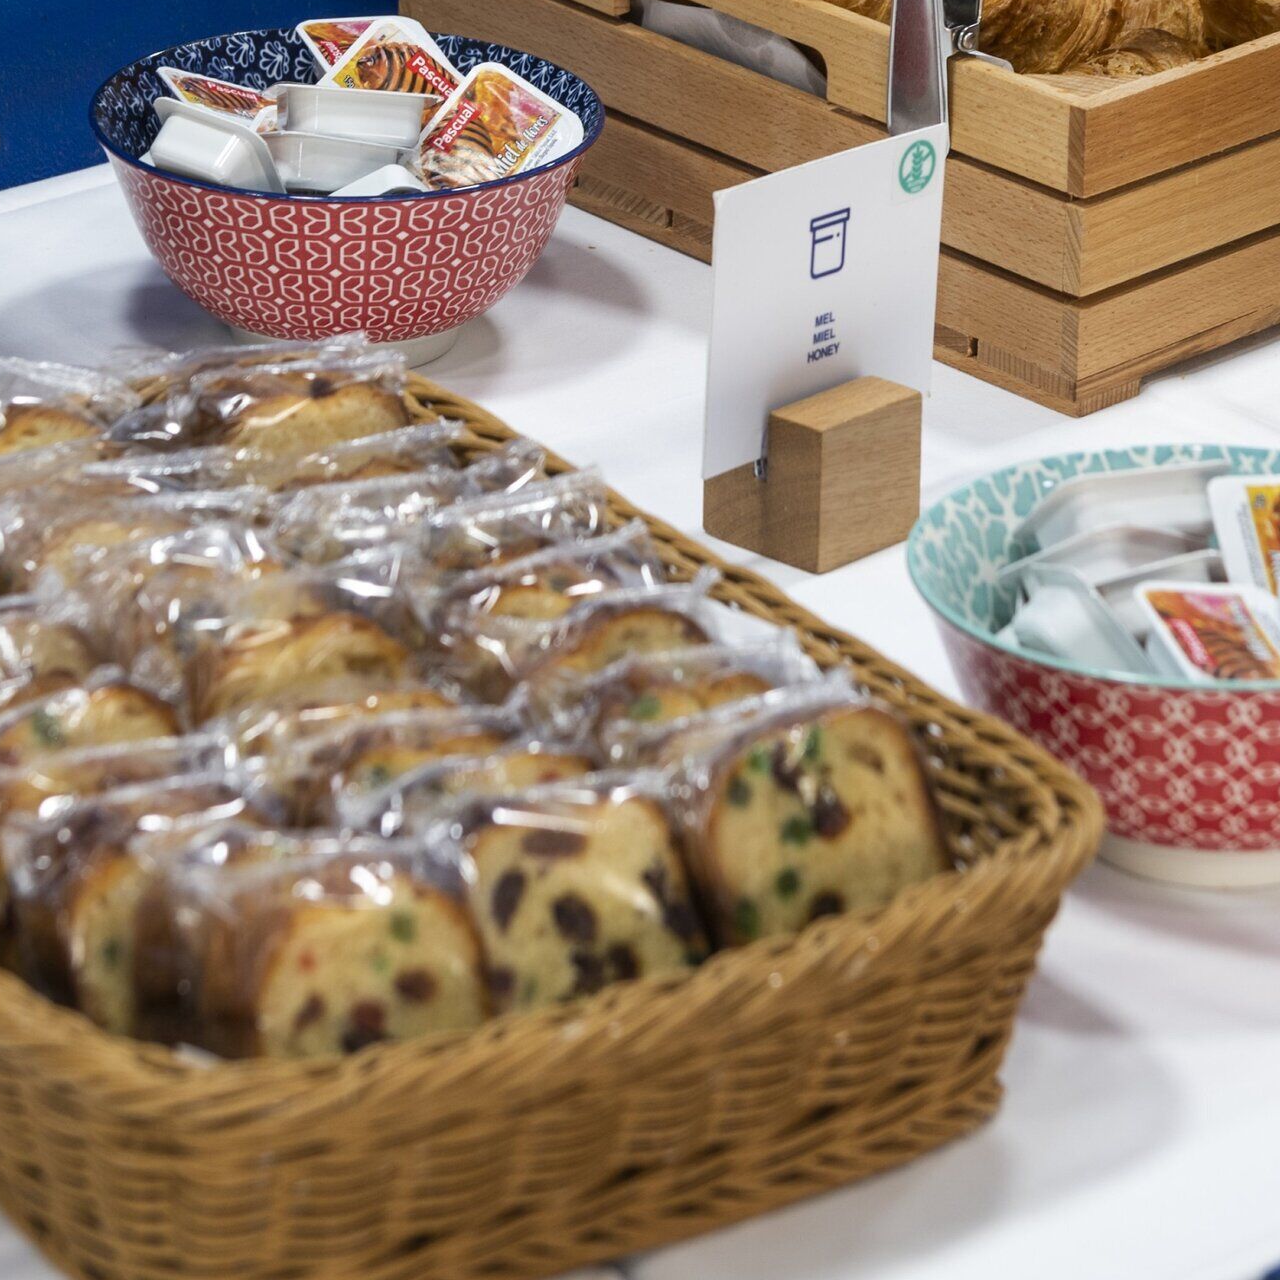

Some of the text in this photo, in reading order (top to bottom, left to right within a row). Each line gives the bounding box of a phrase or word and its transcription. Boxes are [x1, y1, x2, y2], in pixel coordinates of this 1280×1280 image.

[412, 56, 456, 99] Pascua
[433, 102, 476, 151] Pascual
[489, 144, 518, 179] Miel
[516, 139, 528, 152] de
[815, 311, 835, 327] MEL
[807, 341, 840, 363] HONEY
[813, 328, 835, 345] MIEL
